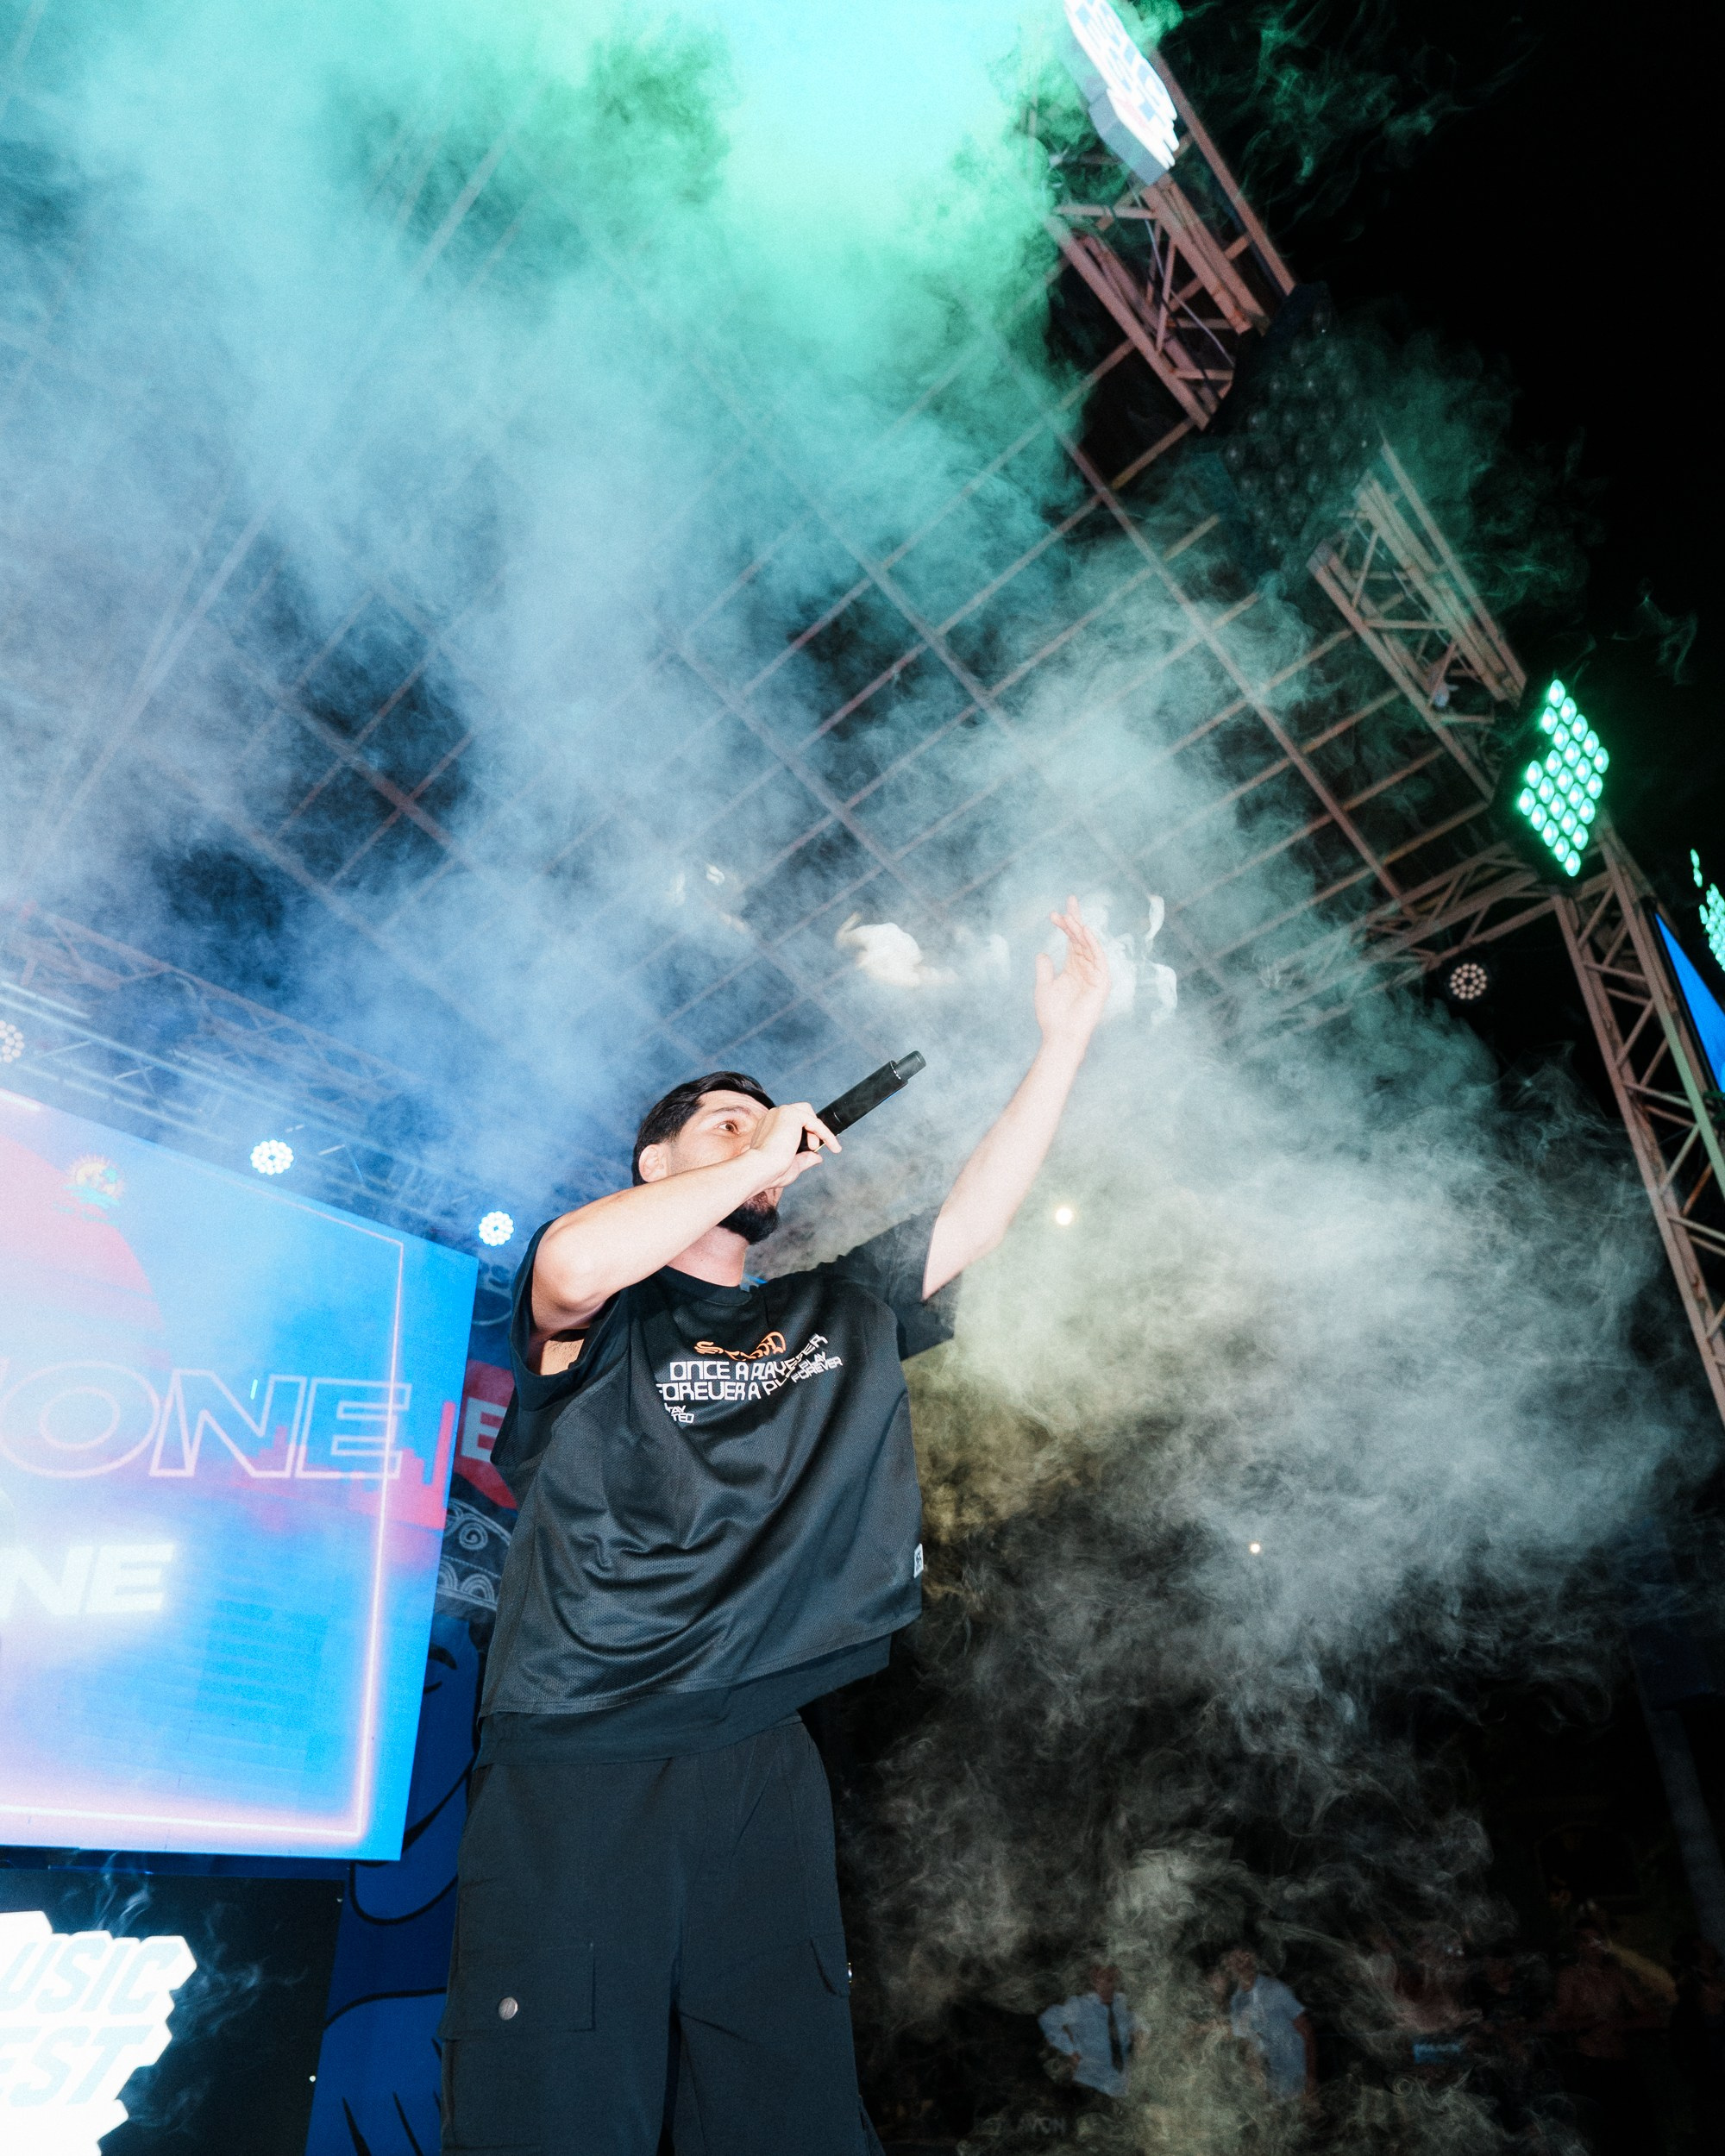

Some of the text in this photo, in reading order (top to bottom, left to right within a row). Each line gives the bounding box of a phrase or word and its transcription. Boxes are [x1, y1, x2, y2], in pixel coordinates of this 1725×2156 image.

[669, 1360, 731, 1381] ONCE
[735, 1361, 750, 1381] A
[747, 1382, 762, 1401] A
[0, 1357, 412, 1480] ONE
